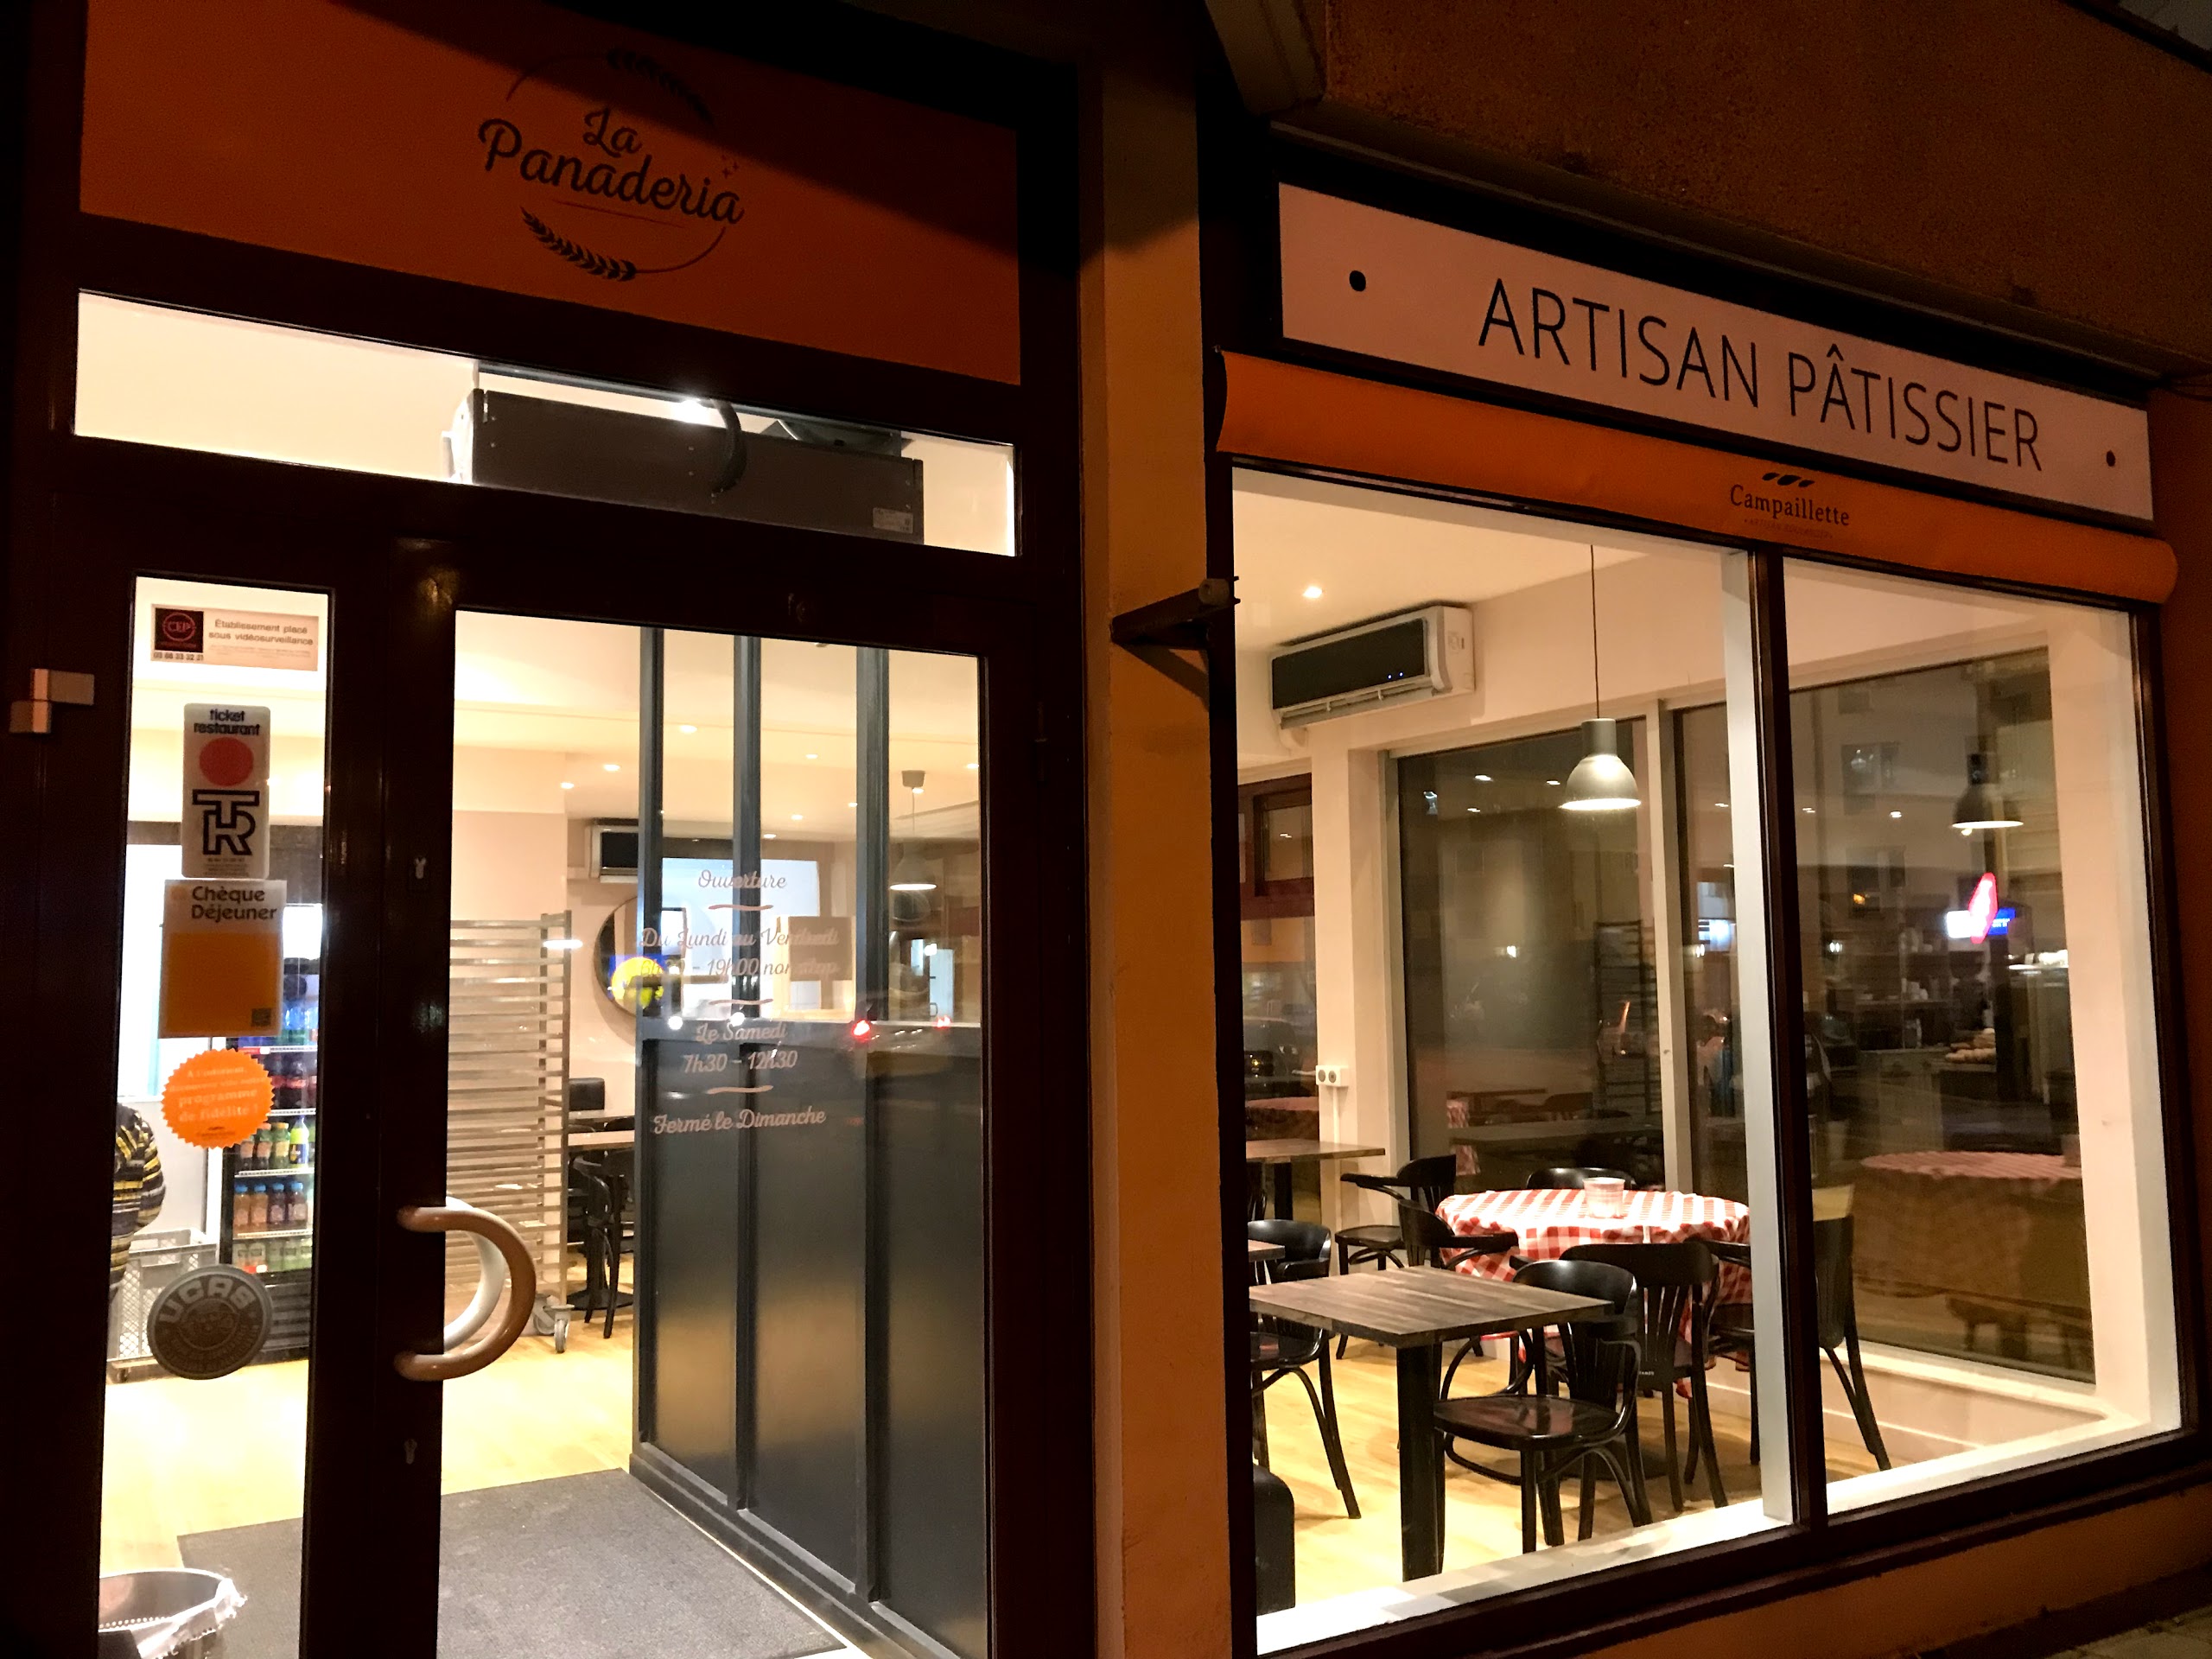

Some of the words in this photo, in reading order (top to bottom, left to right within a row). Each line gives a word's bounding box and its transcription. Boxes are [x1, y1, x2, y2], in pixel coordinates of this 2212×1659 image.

[582, 107, 642, 158] La
[478, 118, 745, 225] Panaderia
[1478, 277, 1759, 408] ARTISAN
[1788, 343, 2043, 472] PÂTISSIER
[1730, 484, 1850, 526] Campaillette
[214, 619, 280, 633] Établissement
[208, 632, 232, 640] sous
[234, 632, 314, 646] vidéosurveillance
[209, 709, 245, 722] ticket
[194, 722, 261, 736] restaurant
[697, 868, 787, 890] Ouverture
[191, 885, 265, 906] Chèque
[191, 904, 277, 924] Déjeuner
[639, 927, 671, 948] Du
[677, 927, 728, 949] Lundi
[696, 1023, 719, 1045] Le
[722, 1022, 787, 1043] Samedi
[683, 1052, 728, 1074] 7h30
[747, 1050, 798, 1070] 12h30
[178, 1089, 257, 1109] programme
[652, 1113, 714, 1135] Fermé
[715, 1109, 734, 1130] le
[735, 1105, 827, 1130] Dimanche
